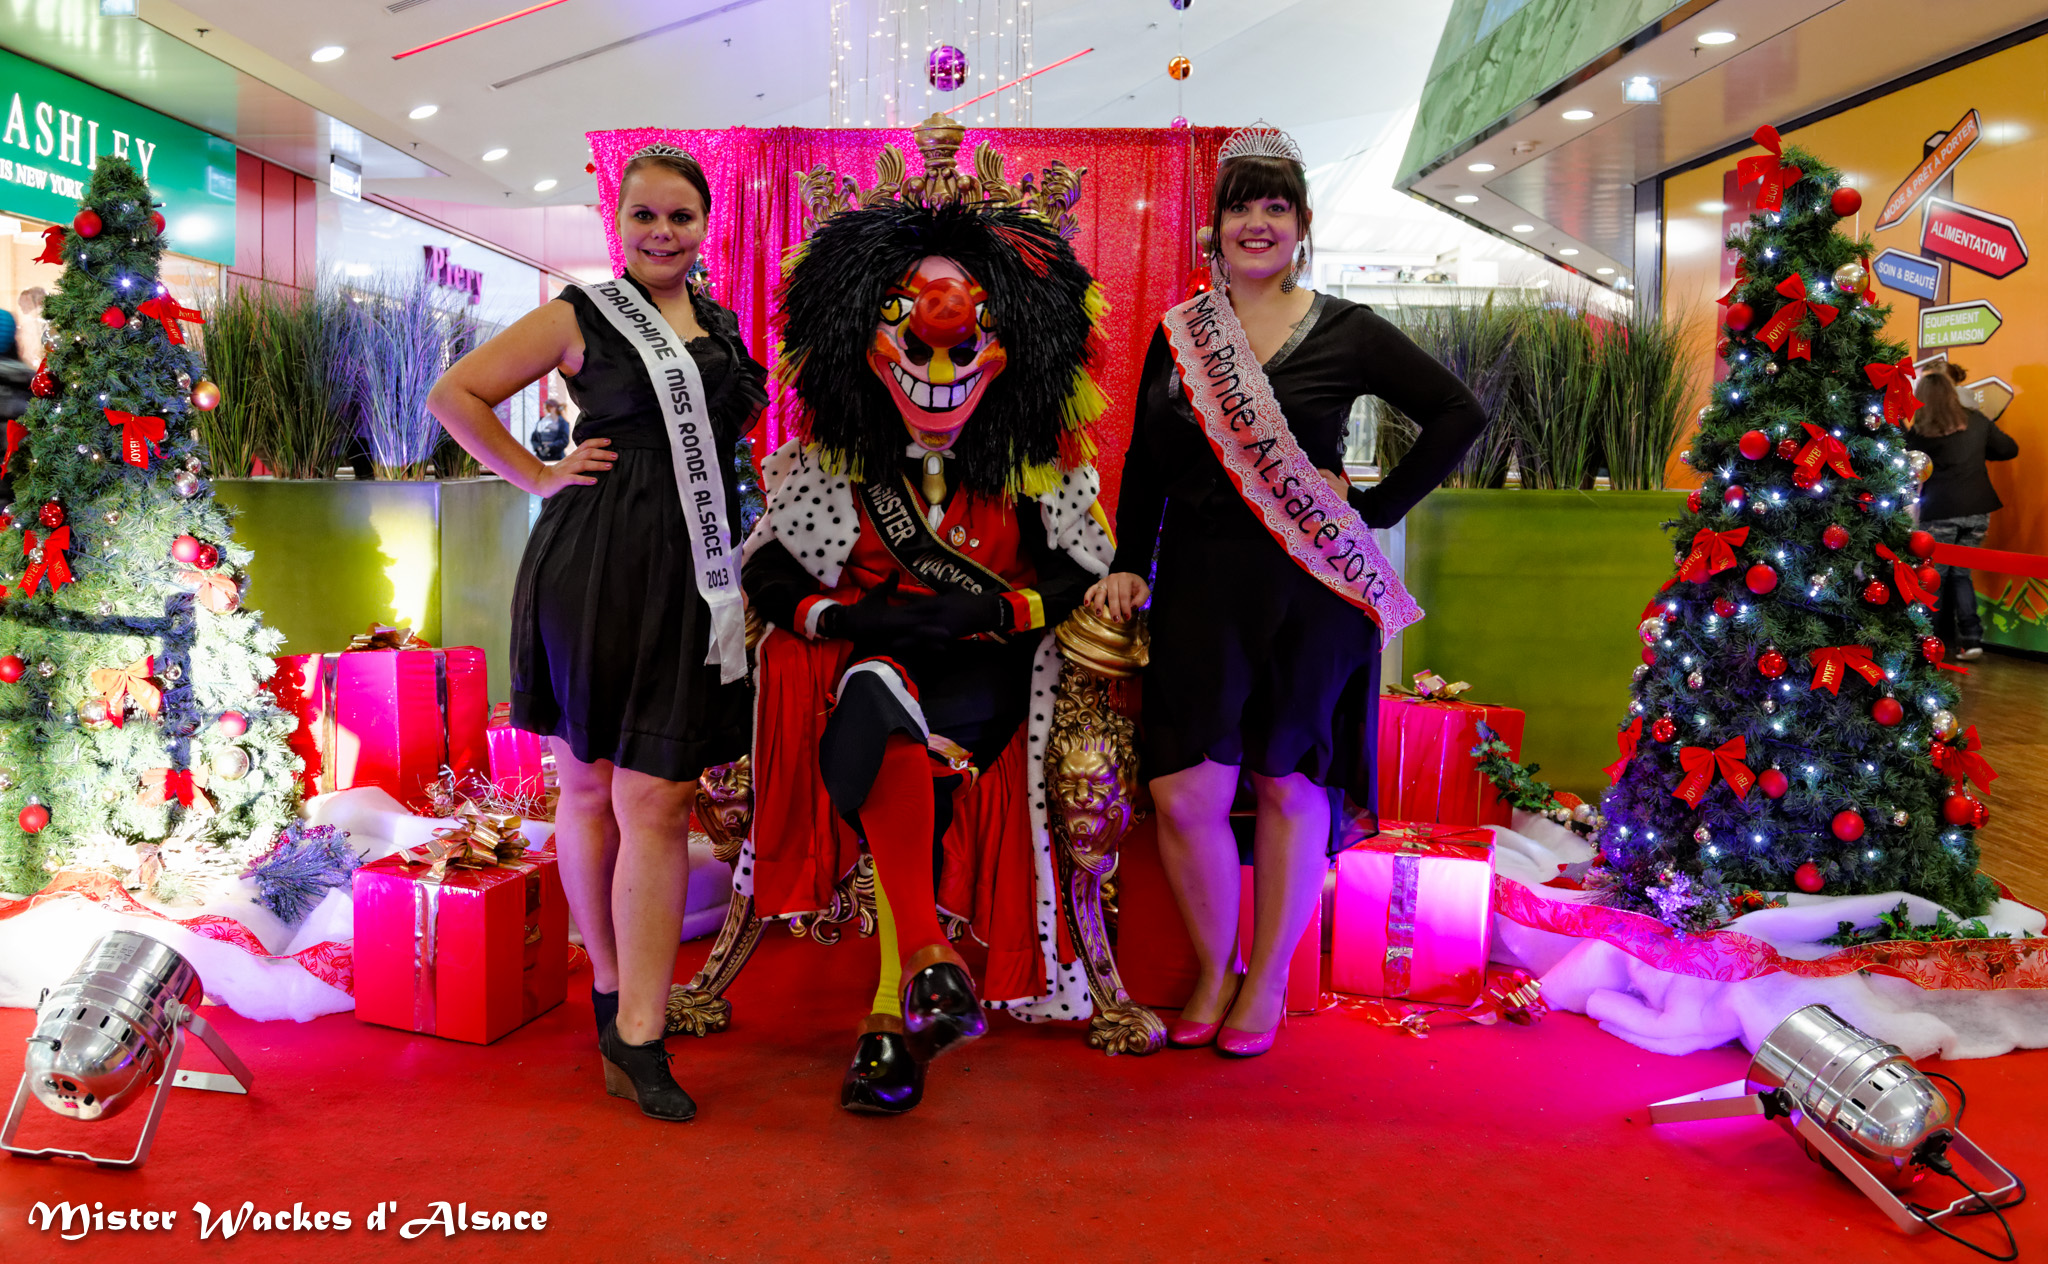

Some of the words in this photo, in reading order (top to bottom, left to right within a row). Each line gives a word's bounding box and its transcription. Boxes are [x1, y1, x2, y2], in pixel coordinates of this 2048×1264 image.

[16, 163, 47, 190] NEW
[50, 173, 84, 200] YORK
[1883, 193, 1905, 222] MODE
[1906, 187, 1913, 198] &
[1912, 163, 1934, 191] PRÊT
[1934, 154, 1941, 169] À
[1940, 120, 1975, 160] PORTER
[1931, 221, 2007, 262] ALIMENTATION
[1878, 261, 1896, 280] SOIN
[1896, 267, 1903, 279] &
[1904, 270, 1935, 290] BEAUTÉ
[600, 287, 677, 361] DAUPHINE
[1925, 311, 1980, 329] ÉQUIPEMENT
[1925, 333, 1937, 345] DE
[1938, 332, 1949, 344] LA
[1950, 328, 1985, 343] MAISON
[665, 368, 692, 416] MISS
[678, 422, 708, 484] RONDE
[694, 490, 722, 560] ALSACE
[868, 483, 916, 547] MISTER
[706, 568, 729, 589] 2013
[1326, 540, 1386, 607] 2013
